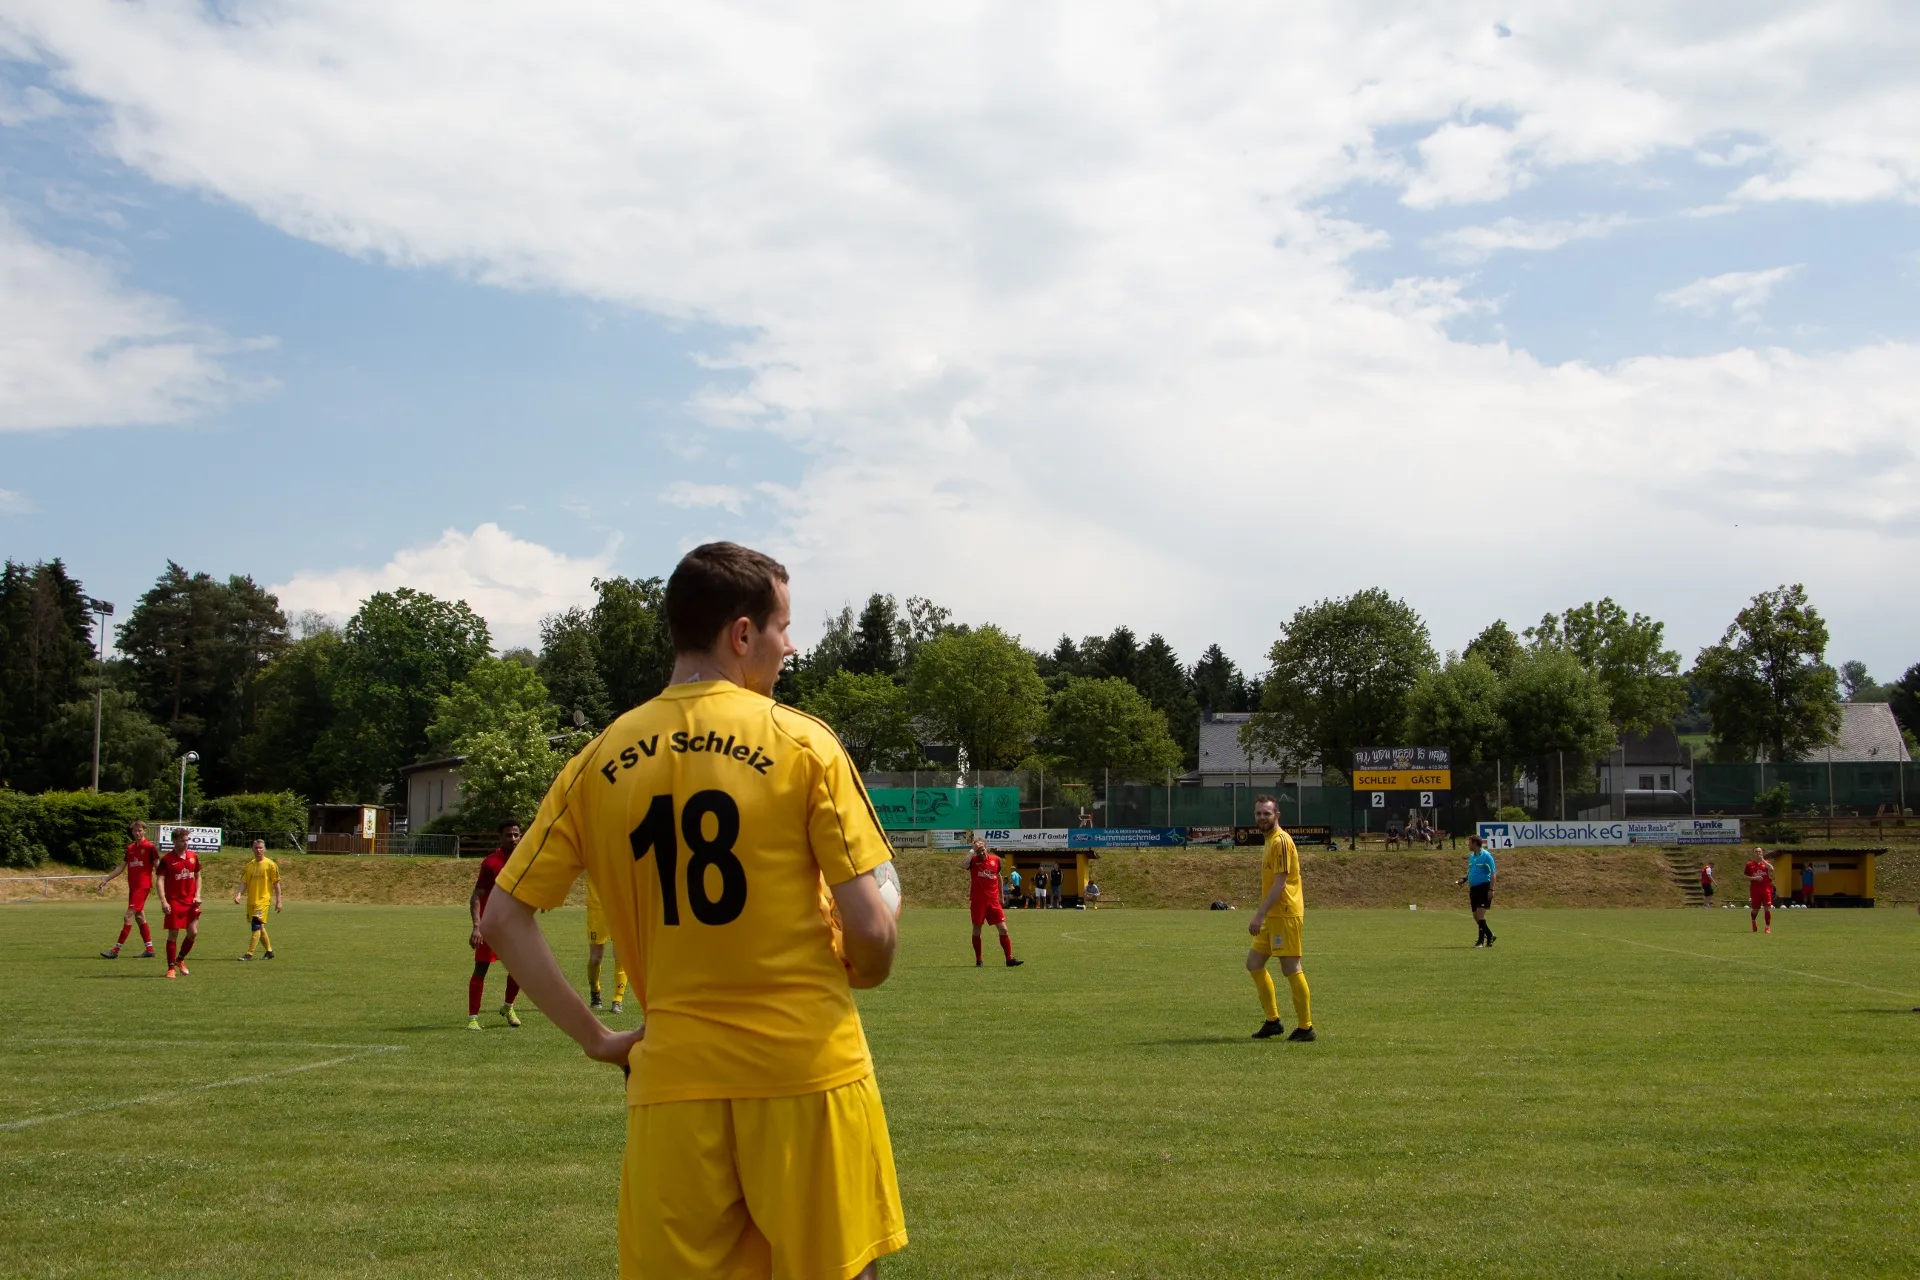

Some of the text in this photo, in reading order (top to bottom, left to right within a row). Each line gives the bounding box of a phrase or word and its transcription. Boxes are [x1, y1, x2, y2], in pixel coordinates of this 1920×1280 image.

[601, 731, 774, 785] FSV Schleiz
[1359, 776, 1397, 785] SCHLEIZ
[1411, 775, 1442, 785] GÄSTE
[1374, 795, 1383, 805] 2
[1423, 794, 1432, 805] 2
[162, 826, 220, 834] GESTBAU
[1284, 826, 1324, 834] ANDBÄCKEREI
[1628, 824, 1647, 832] Maler
[1694, 821, 1723, 829] Funke
[985, 830, 1011, 840] HBS
[1038, 832, 1047, 840] IT
[1512, 824, 1623, 840] Volksbank eG
[629, 789, 747, 926] 18
